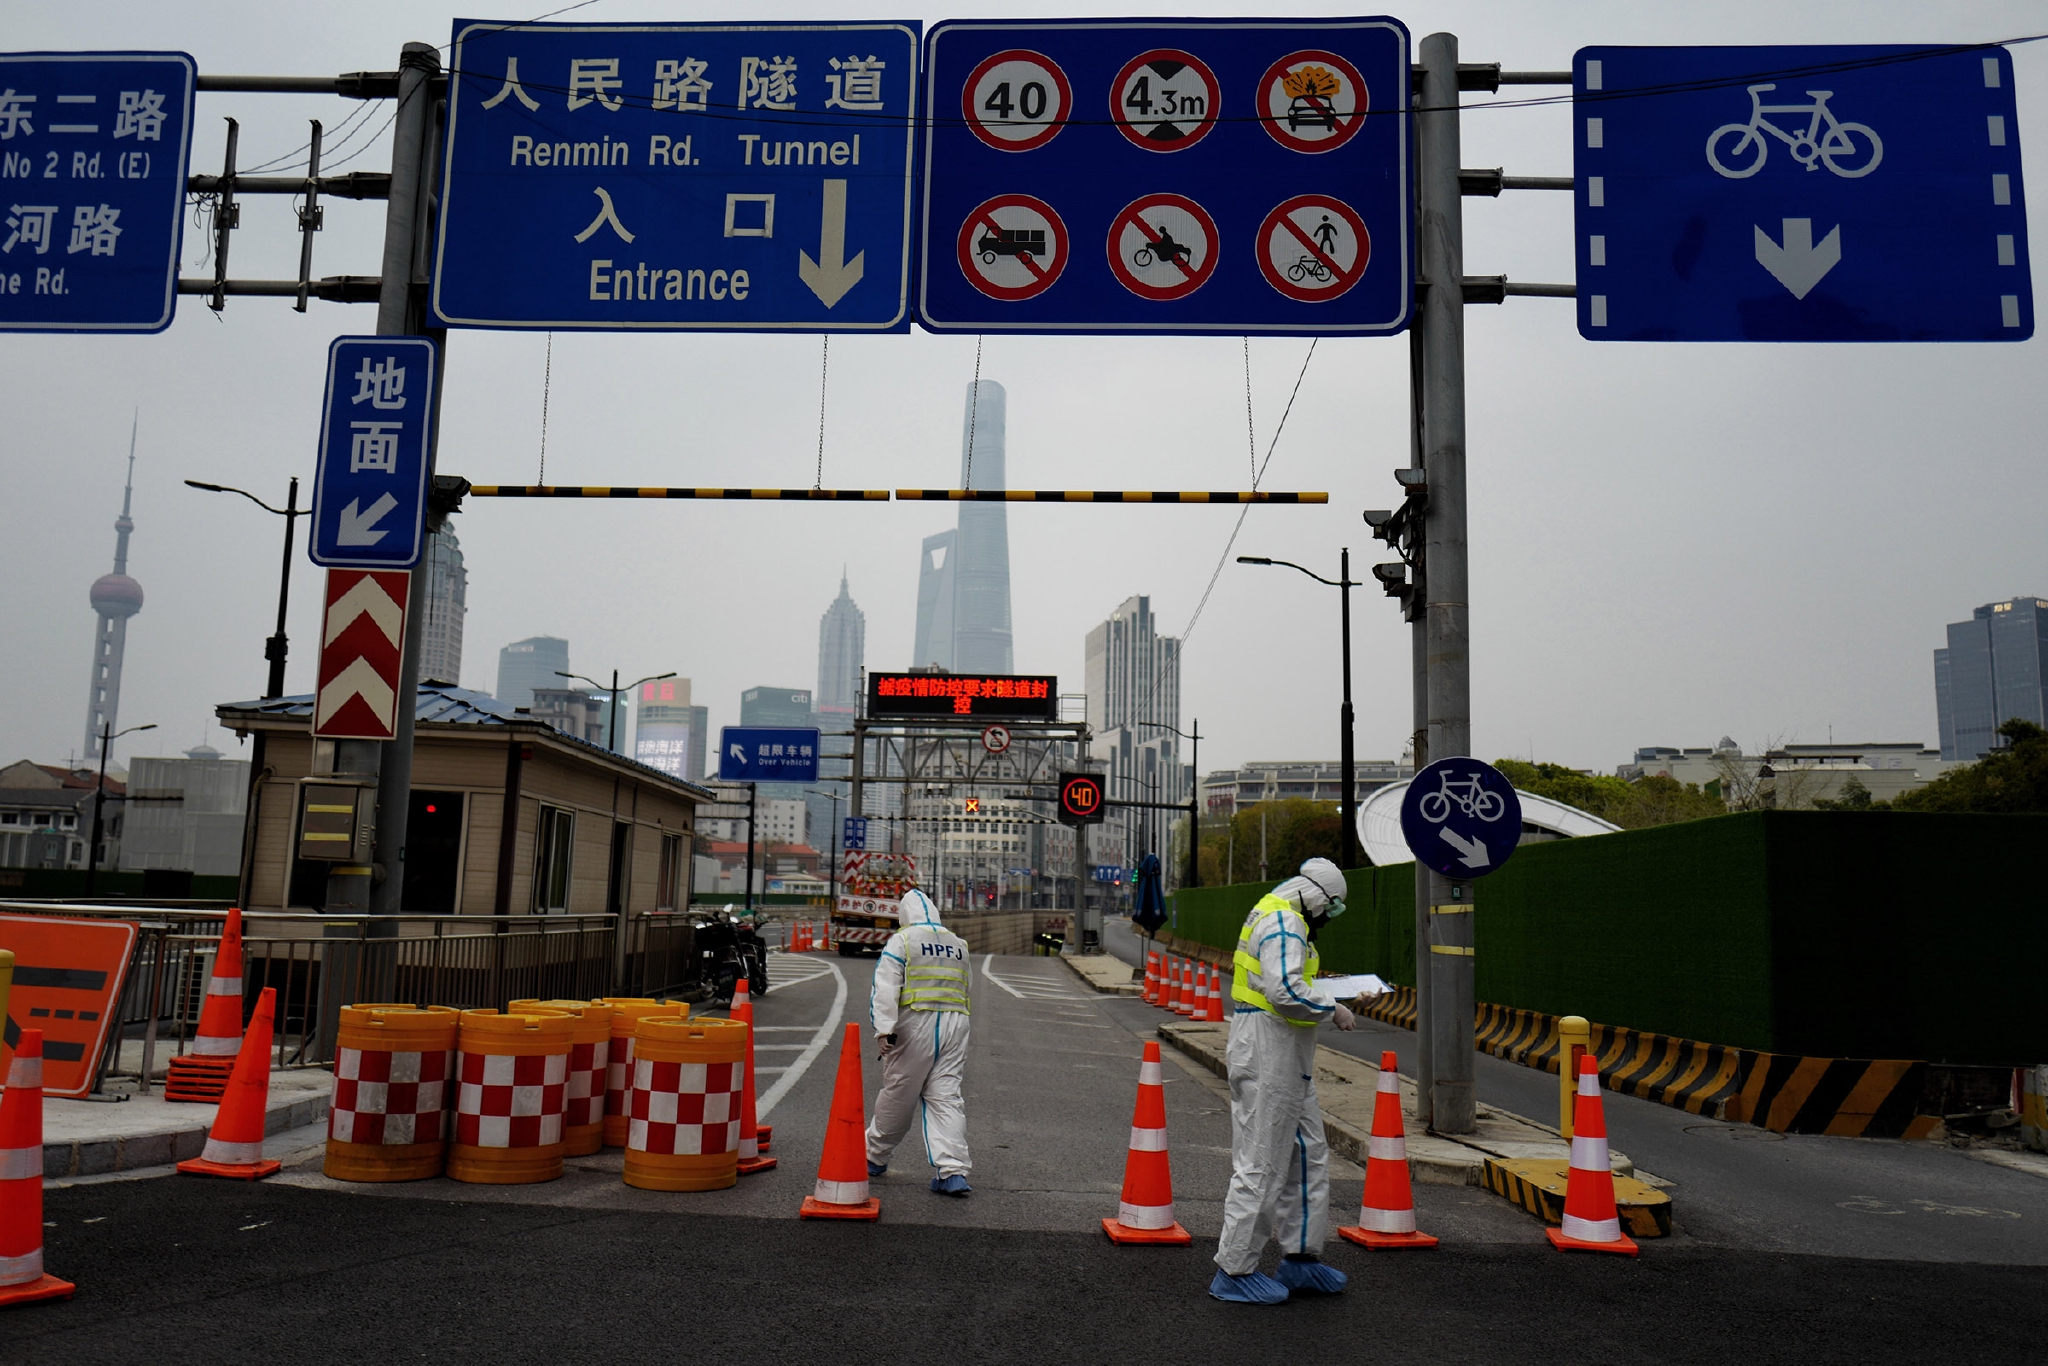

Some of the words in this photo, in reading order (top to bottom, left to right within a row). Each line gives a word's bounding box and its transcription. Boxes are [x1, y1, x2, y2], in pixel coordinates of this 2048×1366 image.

[481, 54, 886, 112] 人民路隧道
[984, 80, 1047, 119] 40
[1126, 75, 1205, 116] 4.3m
[0, 88, 168, 141] 东二路
[2, 151, 32, 178] No
[43, 151, 59, 178] 2
[72, 151, 106, 178] Rd.
[118, 152, 150, 179] (E)
[510, 134, 629, 166] Renmin
[648, 134, 700, 166] Rd.
[738, 134, 860, 166] Tunnel
[2, 203, 123, 257] 河路
[574, 186, 776, 245] 入口
[35, 267, 69, 295] Rd.
[589, 259, 750, 300] Entrance
[350, 356, 407, 474] 地面
[758, 744, 812, 757] 超限车辆
[758, 758, 777, 766] Over
[780, 758, 811, 766] Vehicle
[1071, 787, 1092, 806] 40
[921, 943, 963, 960] HPFJ
